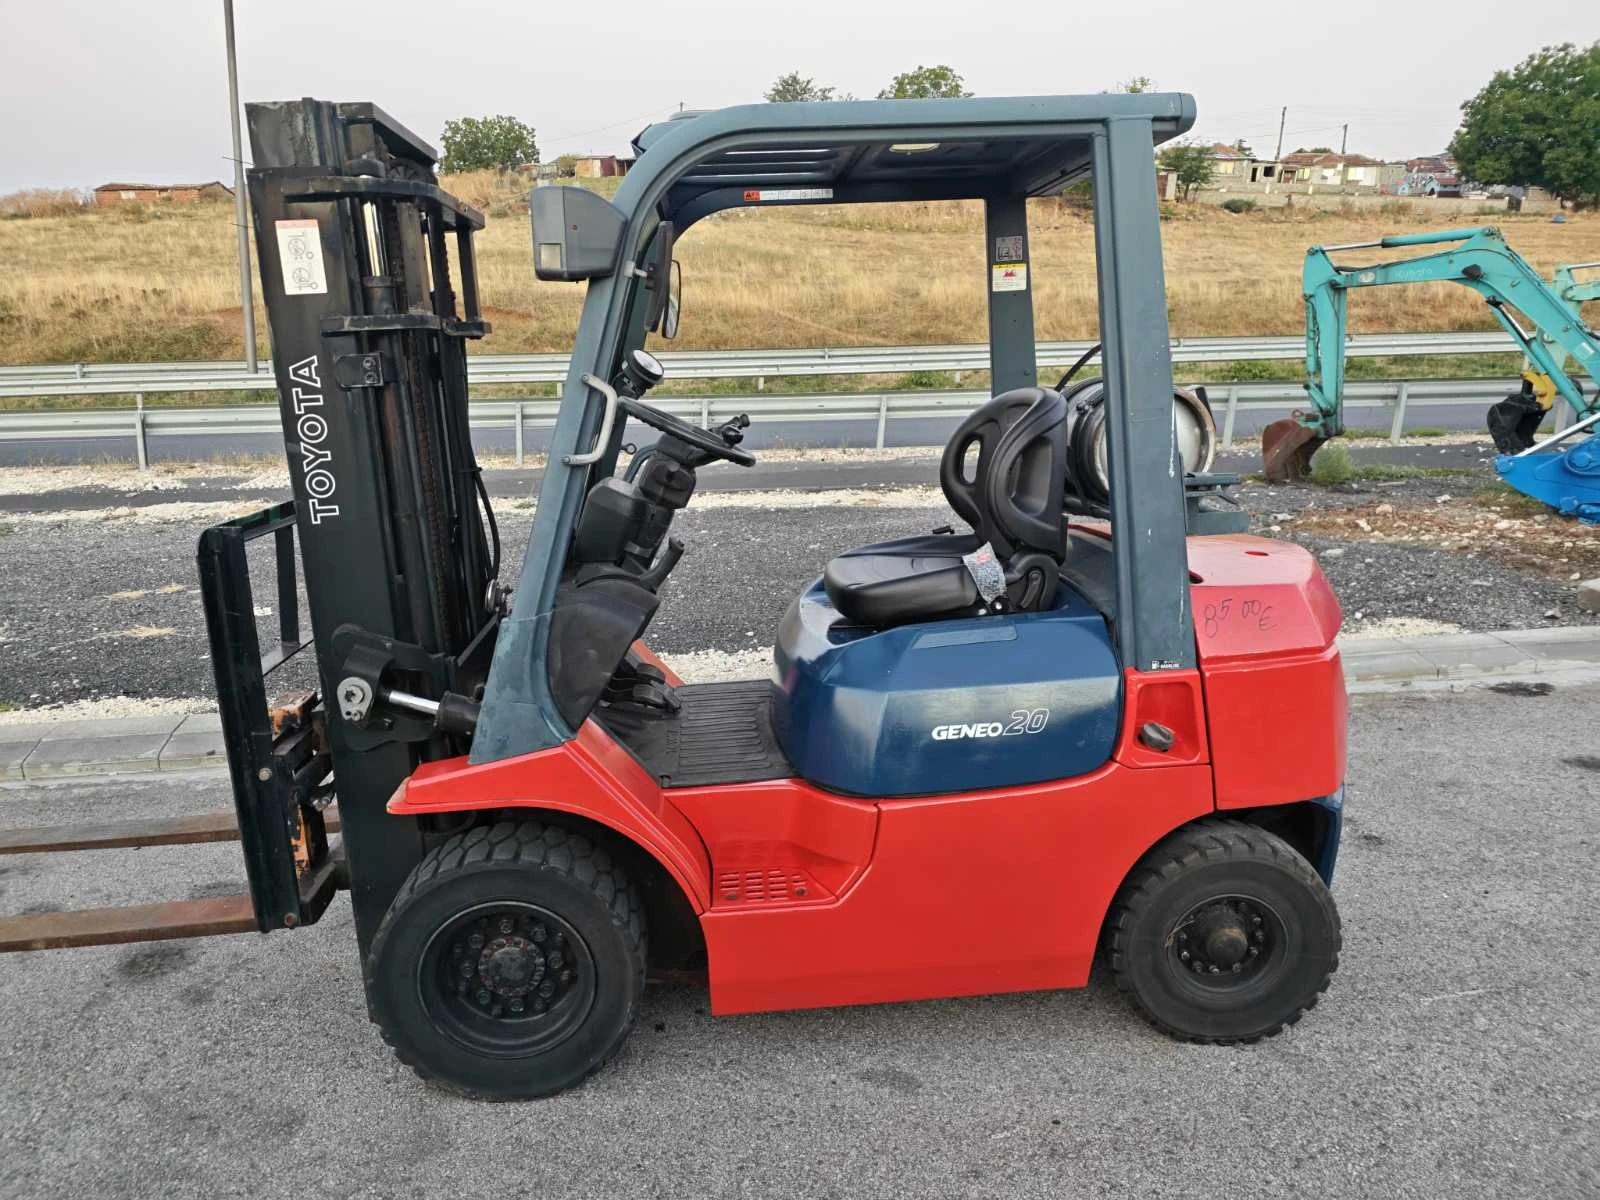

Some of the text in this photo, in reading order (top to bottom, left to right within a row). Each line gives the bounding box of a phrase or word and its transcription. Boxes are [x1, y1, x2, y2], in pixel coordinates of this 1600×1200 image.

[289, 355, 340, 525] TOYOTA
[931, 707, 1049, 740] GENEO 20
